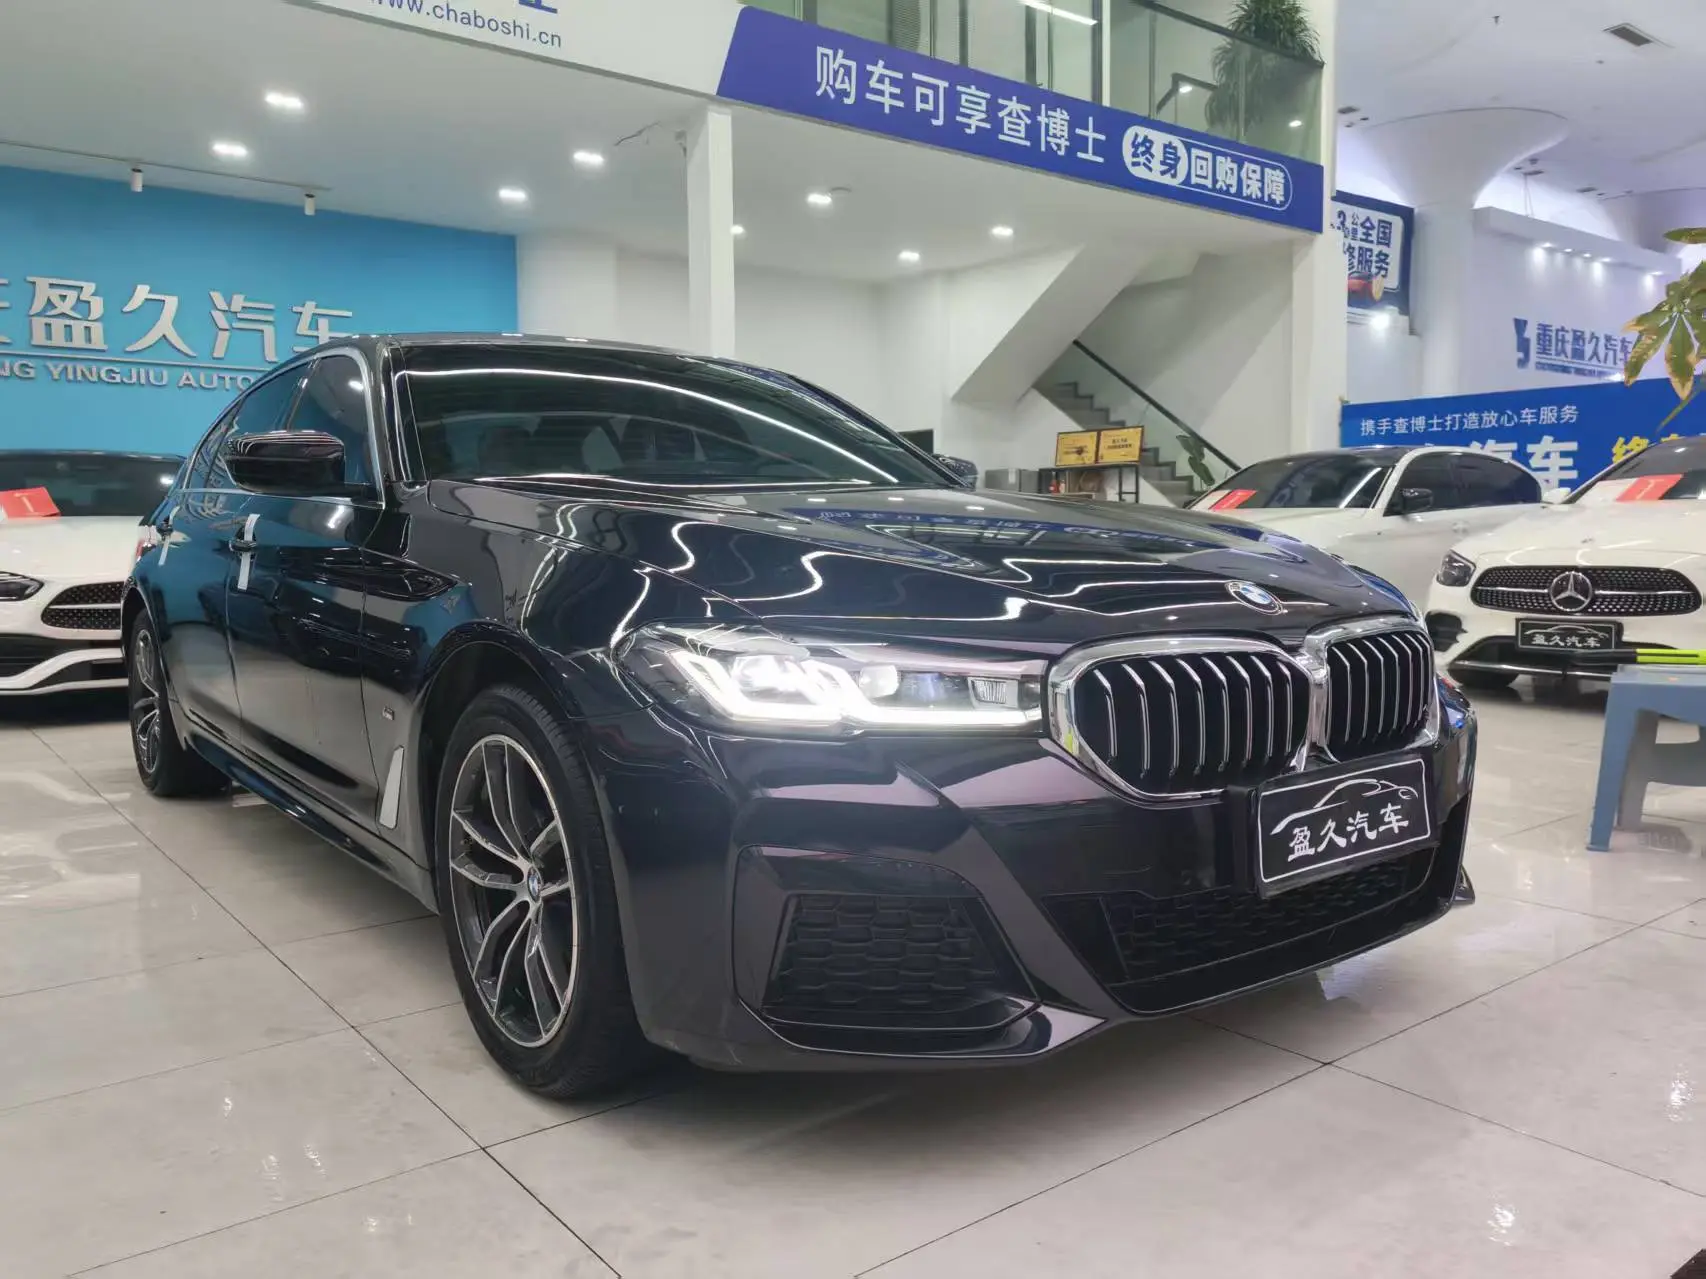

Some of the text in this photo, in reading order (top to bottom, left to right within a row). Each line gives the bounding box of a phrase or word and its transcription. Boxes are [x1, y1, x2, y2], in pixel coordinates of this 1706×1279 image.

[815, 46, 1285, 205] 购车可享查博士 终身回购保障
[0, 276, 353, 363] 盈久汽车
[46, 361, 168, 387] YINGJIU
[1360, 405, 1579, 437] 携手查博士打造放心车服务
[1287, 802, 1409, 863] 盈久汽车
